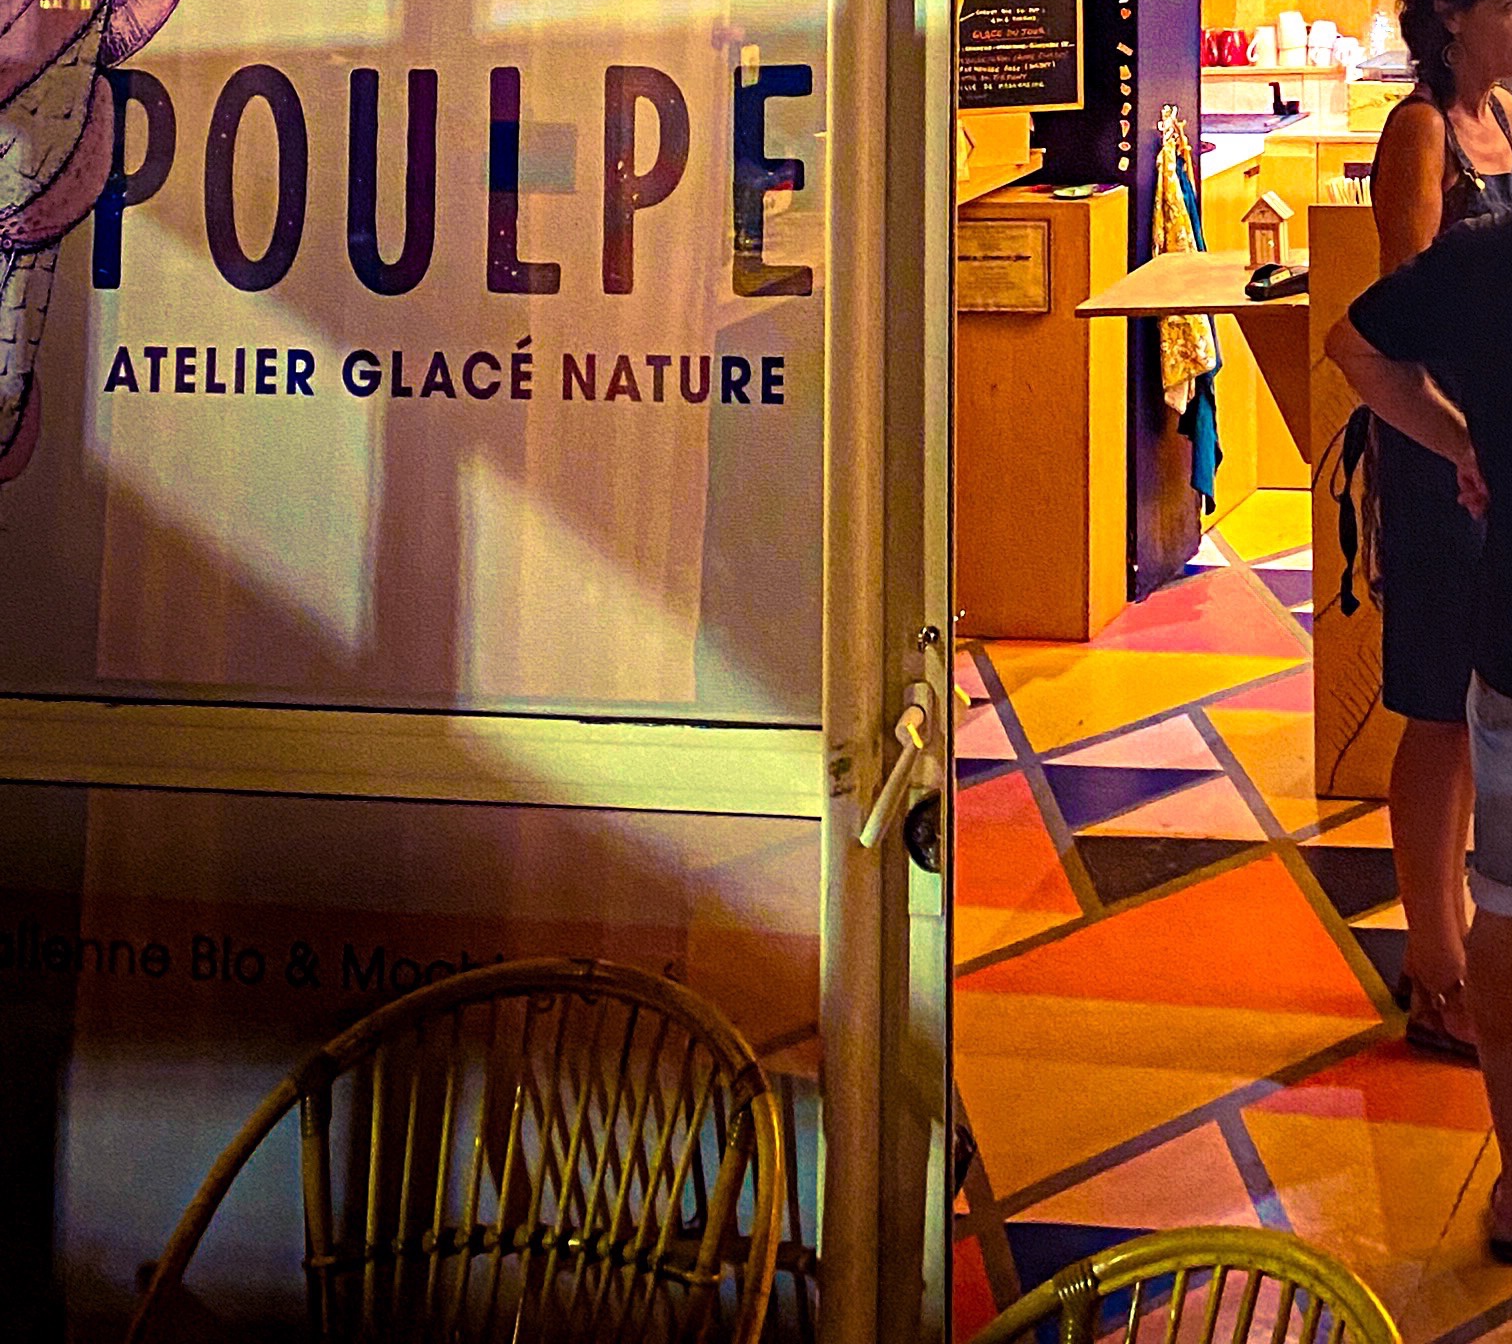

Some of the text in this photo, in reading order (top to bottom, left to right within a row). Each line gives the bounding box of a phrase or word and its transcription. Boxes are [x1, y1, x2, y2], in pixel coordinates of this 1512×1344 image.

[91, 64, 815, 297] POULPE
[104, 335, 786, 405] ATELIER GLACÉ NATURE
[286, 941, 320, 989] &
